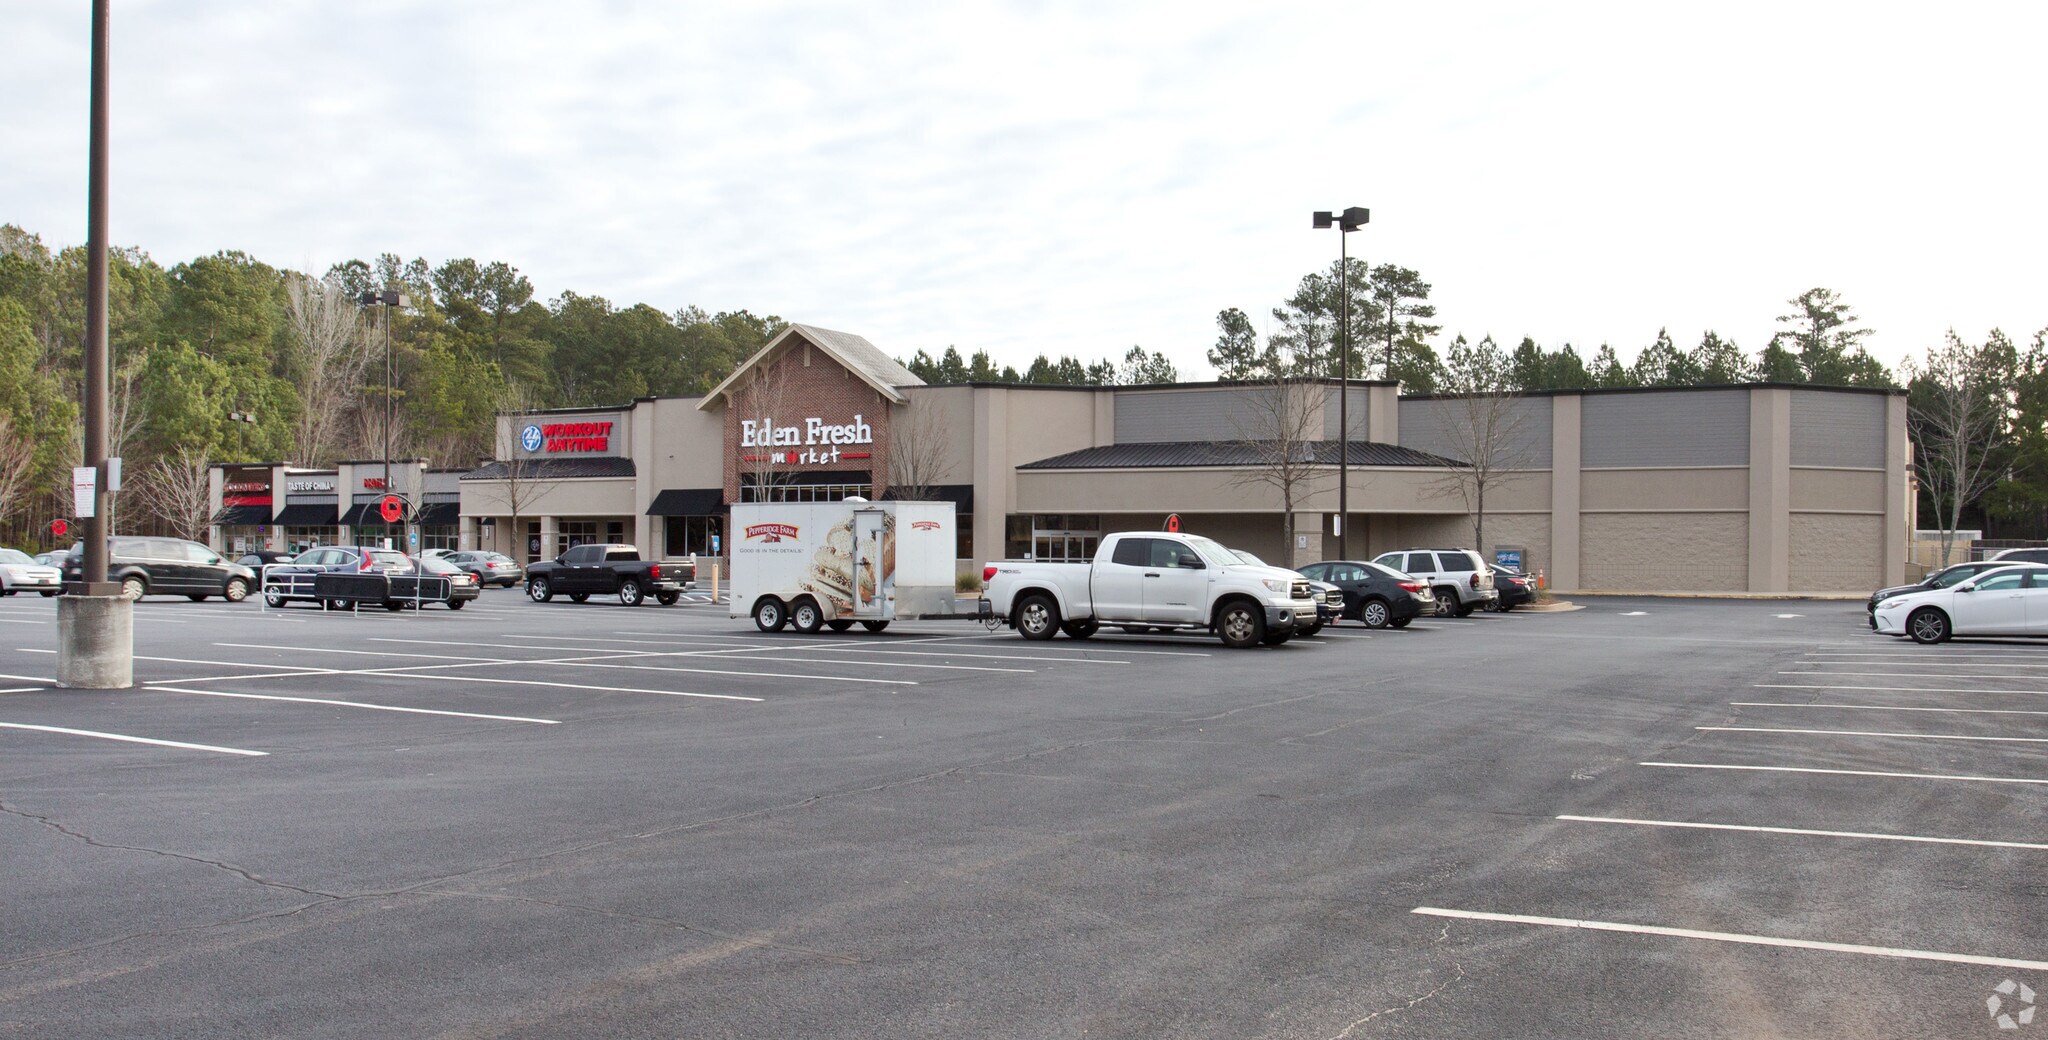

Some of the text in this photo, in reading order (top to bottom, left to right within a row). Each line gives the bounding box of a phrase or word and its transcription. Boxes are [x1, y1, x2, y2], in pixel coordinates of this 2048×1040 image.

[542, 422, 612, 437] WORKOUT
[741, 414, 873, 447] Eden Fresh
[546, 437, 608, 451] ANYTIME
[771, 445, 841, 465] market
[287, 481, 331, 491] TASTE OF CHINA
[748, 525, 795, 537] PEPPERIDGE FARM
